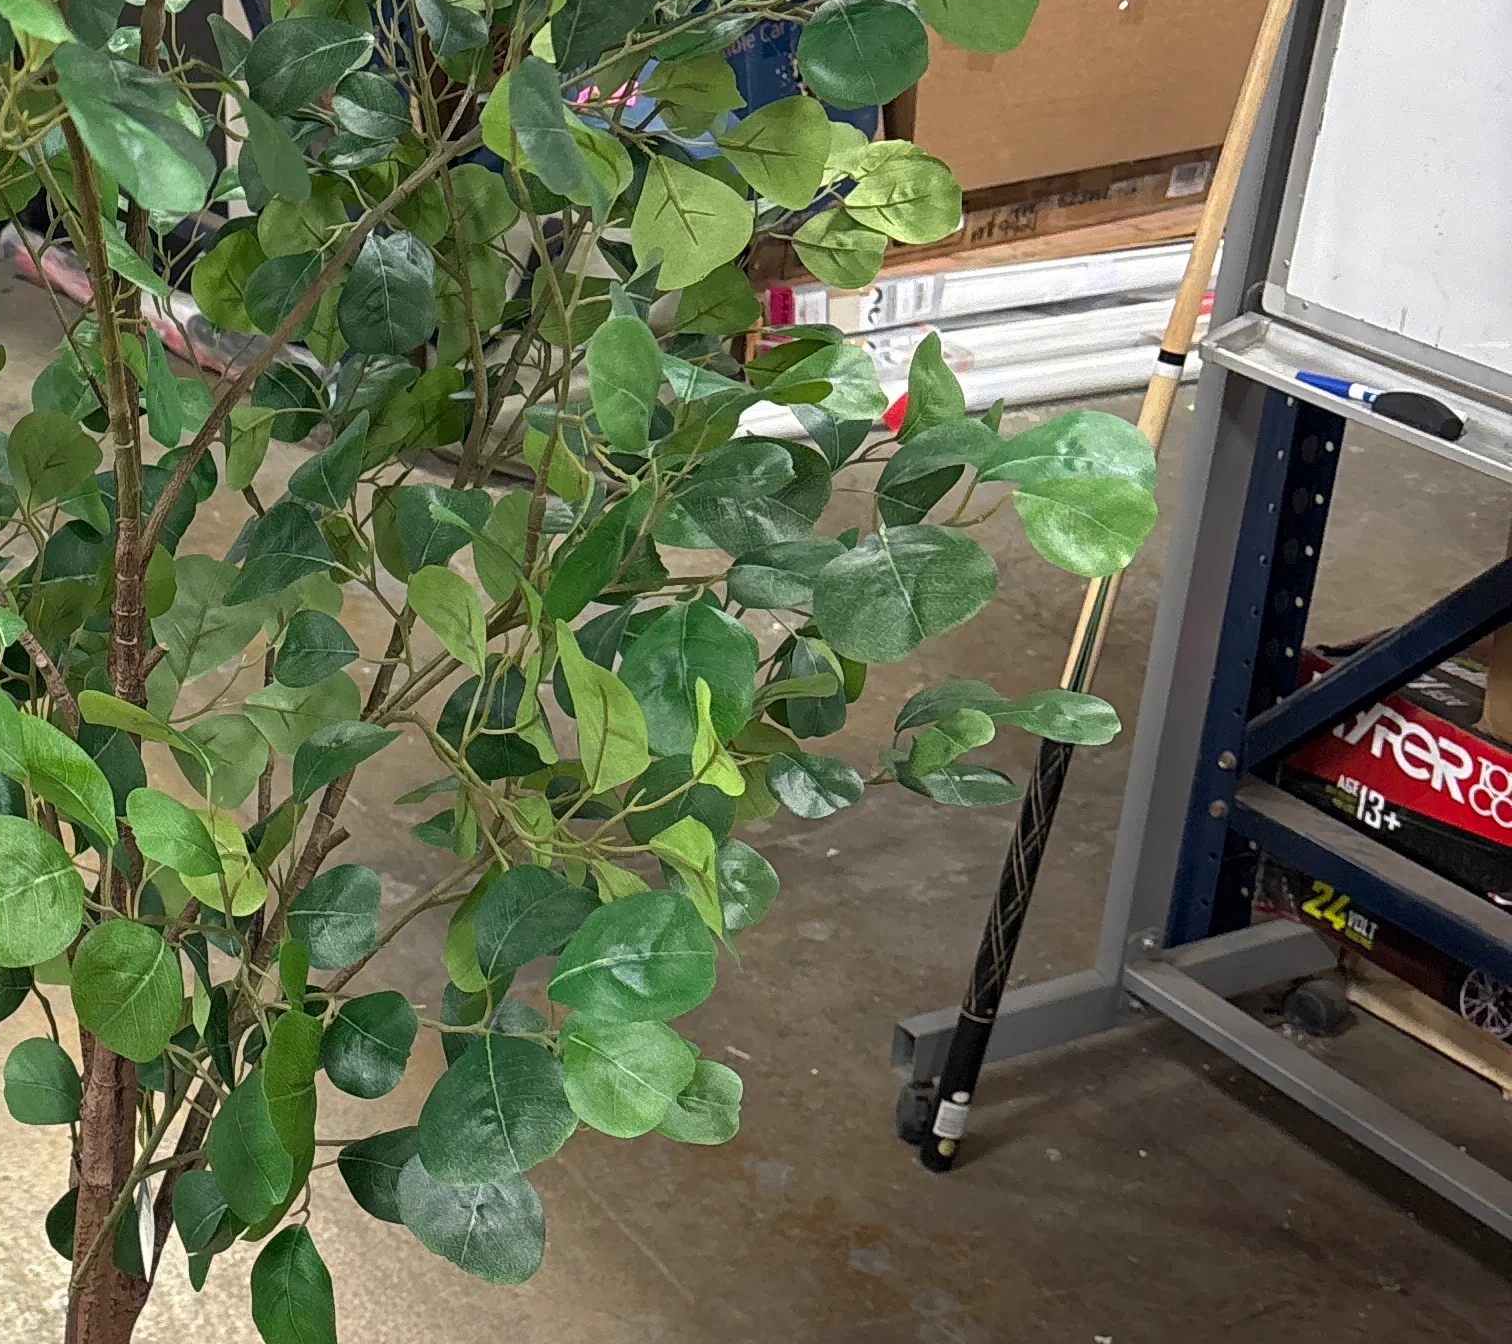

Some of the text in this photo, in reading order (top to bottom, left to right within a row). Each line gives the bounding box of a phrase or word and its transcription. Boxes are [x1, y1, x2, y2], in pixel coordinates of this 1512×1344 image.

[1334, 703, 1474, 805] YPER
[1356, 784, 1402, 832] 13+
[1302, 880, 1350, 932] 24
